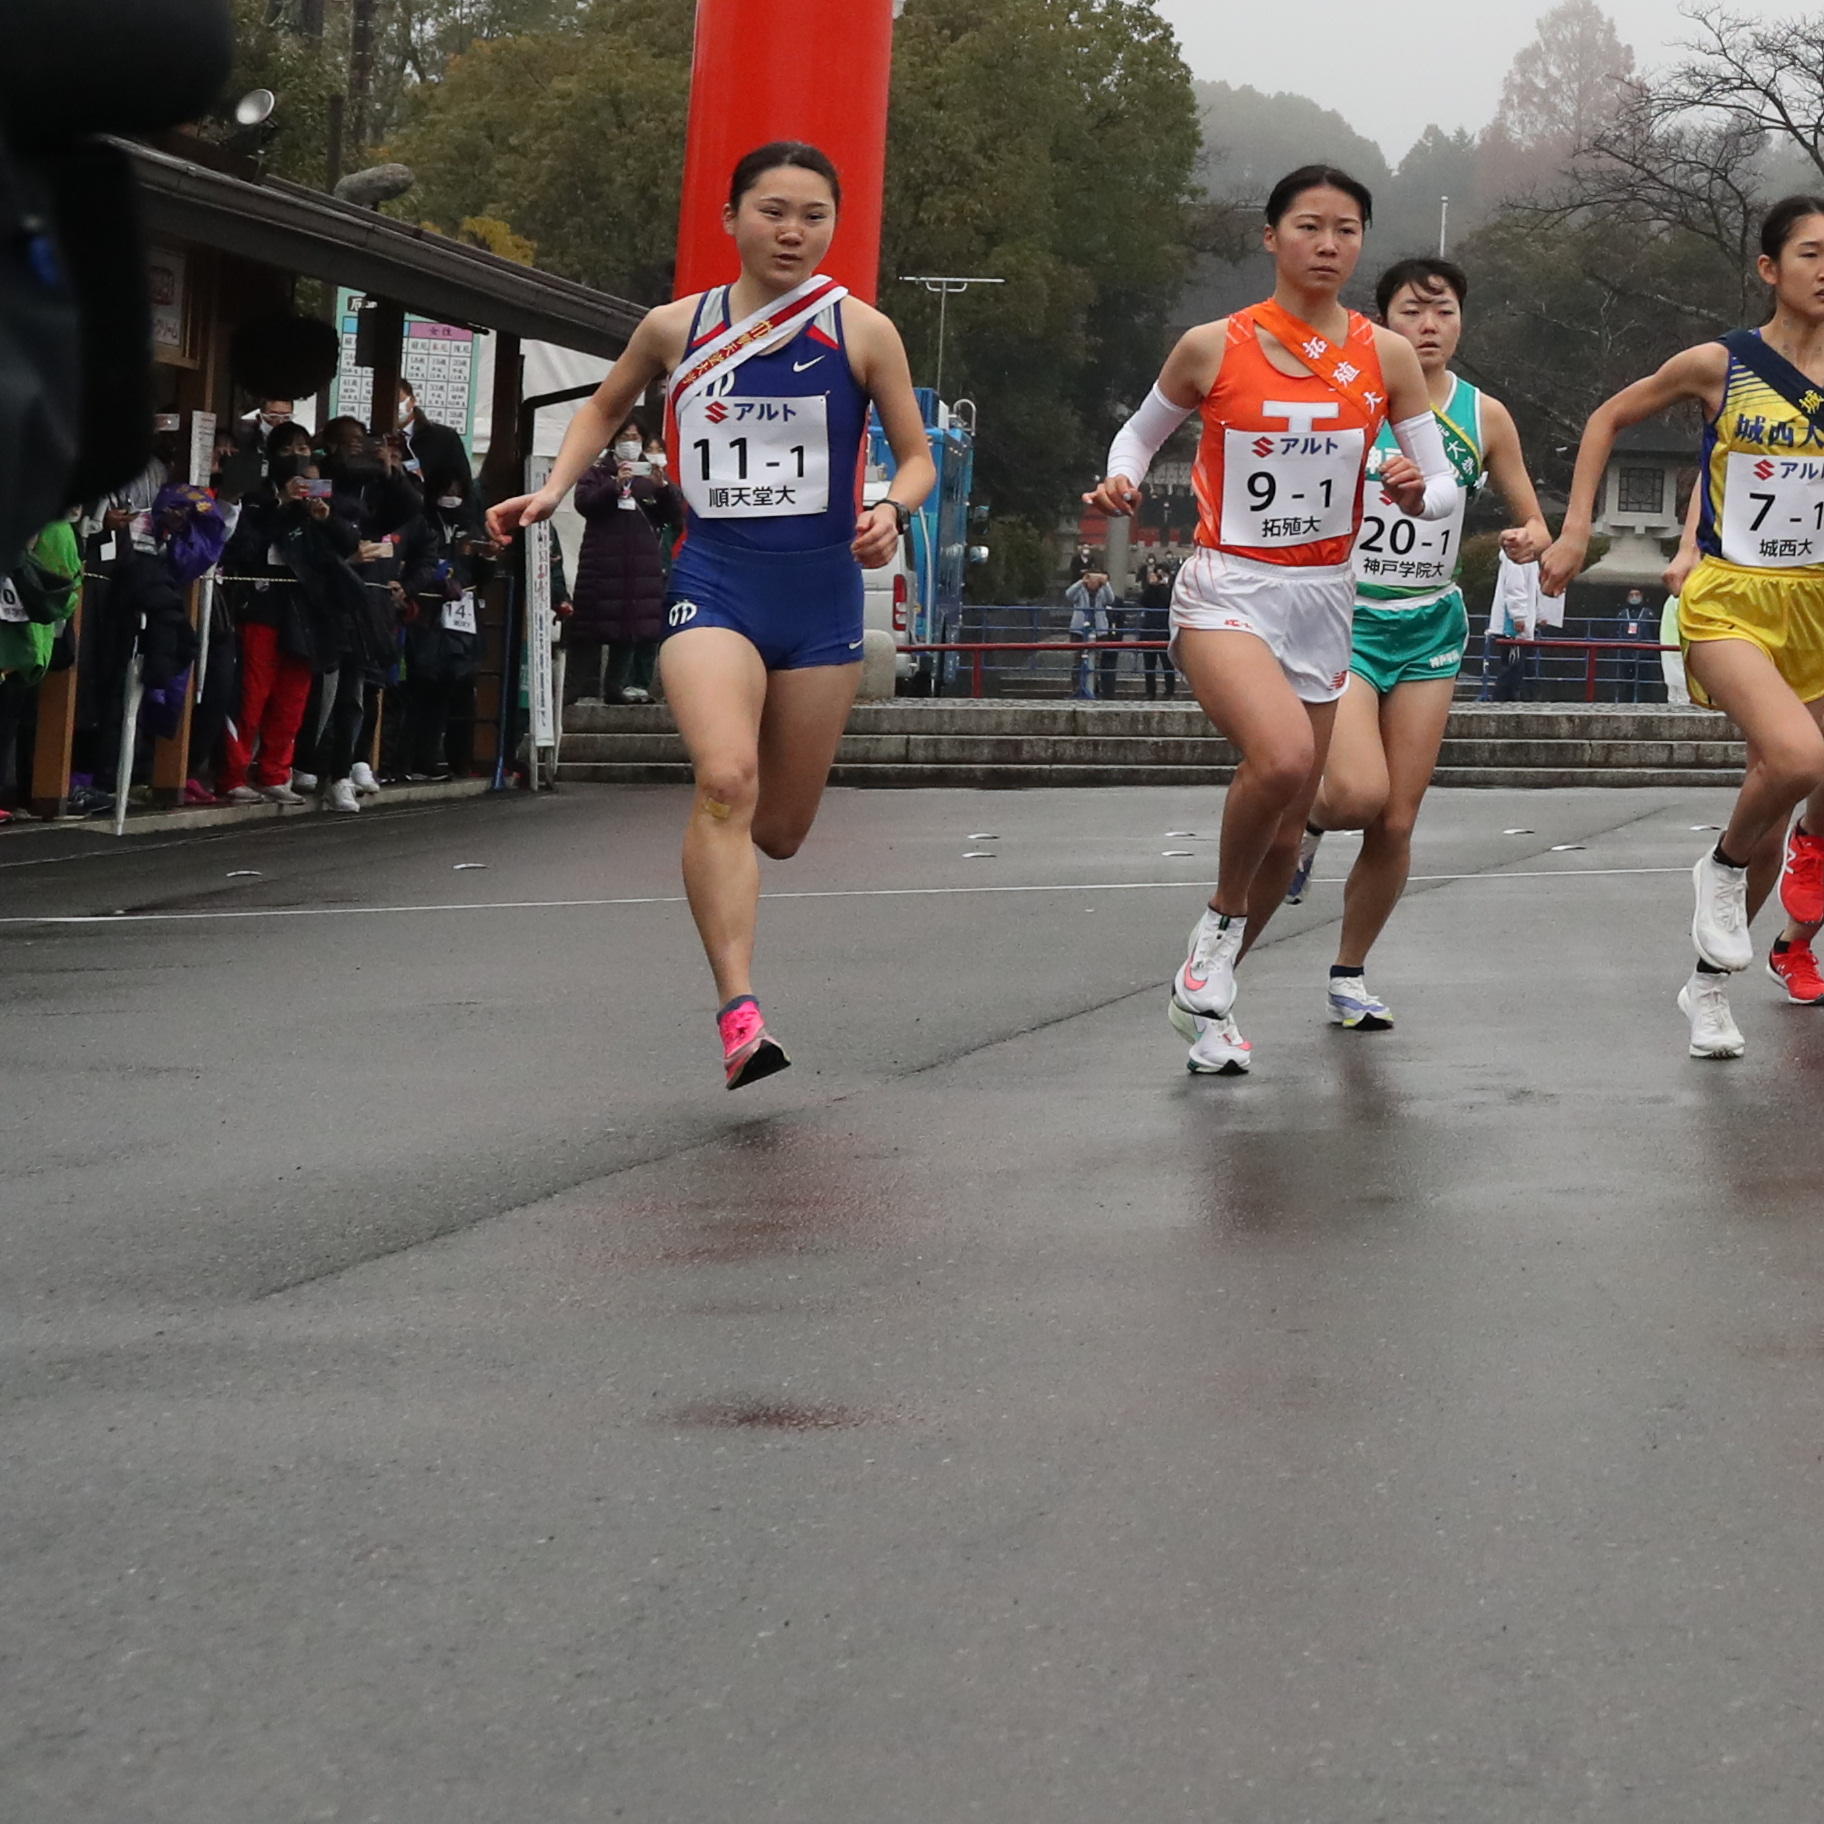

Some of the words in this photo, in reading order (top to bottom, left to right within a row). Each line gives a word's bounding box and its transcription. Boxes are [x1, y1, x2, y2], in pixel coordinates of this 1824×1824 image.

[734, 403, 796, 422] アルト
[1280, 437, 1338, 455] アルト
[693, 437, 804, 481] 11-1
[709, 485, 796, 508] 順天堂大
[1247, 471, 1332, 512] 9-1
[1749, 492, 1824, 531] 7-1
[1261, 516, 1322, 538] 拓殖大
[1359, 515, 1450, 557] 20-1
[1759, 538, 1815, 558] 城西大
[1363, 557, 1445, 578] 神戸学院大
